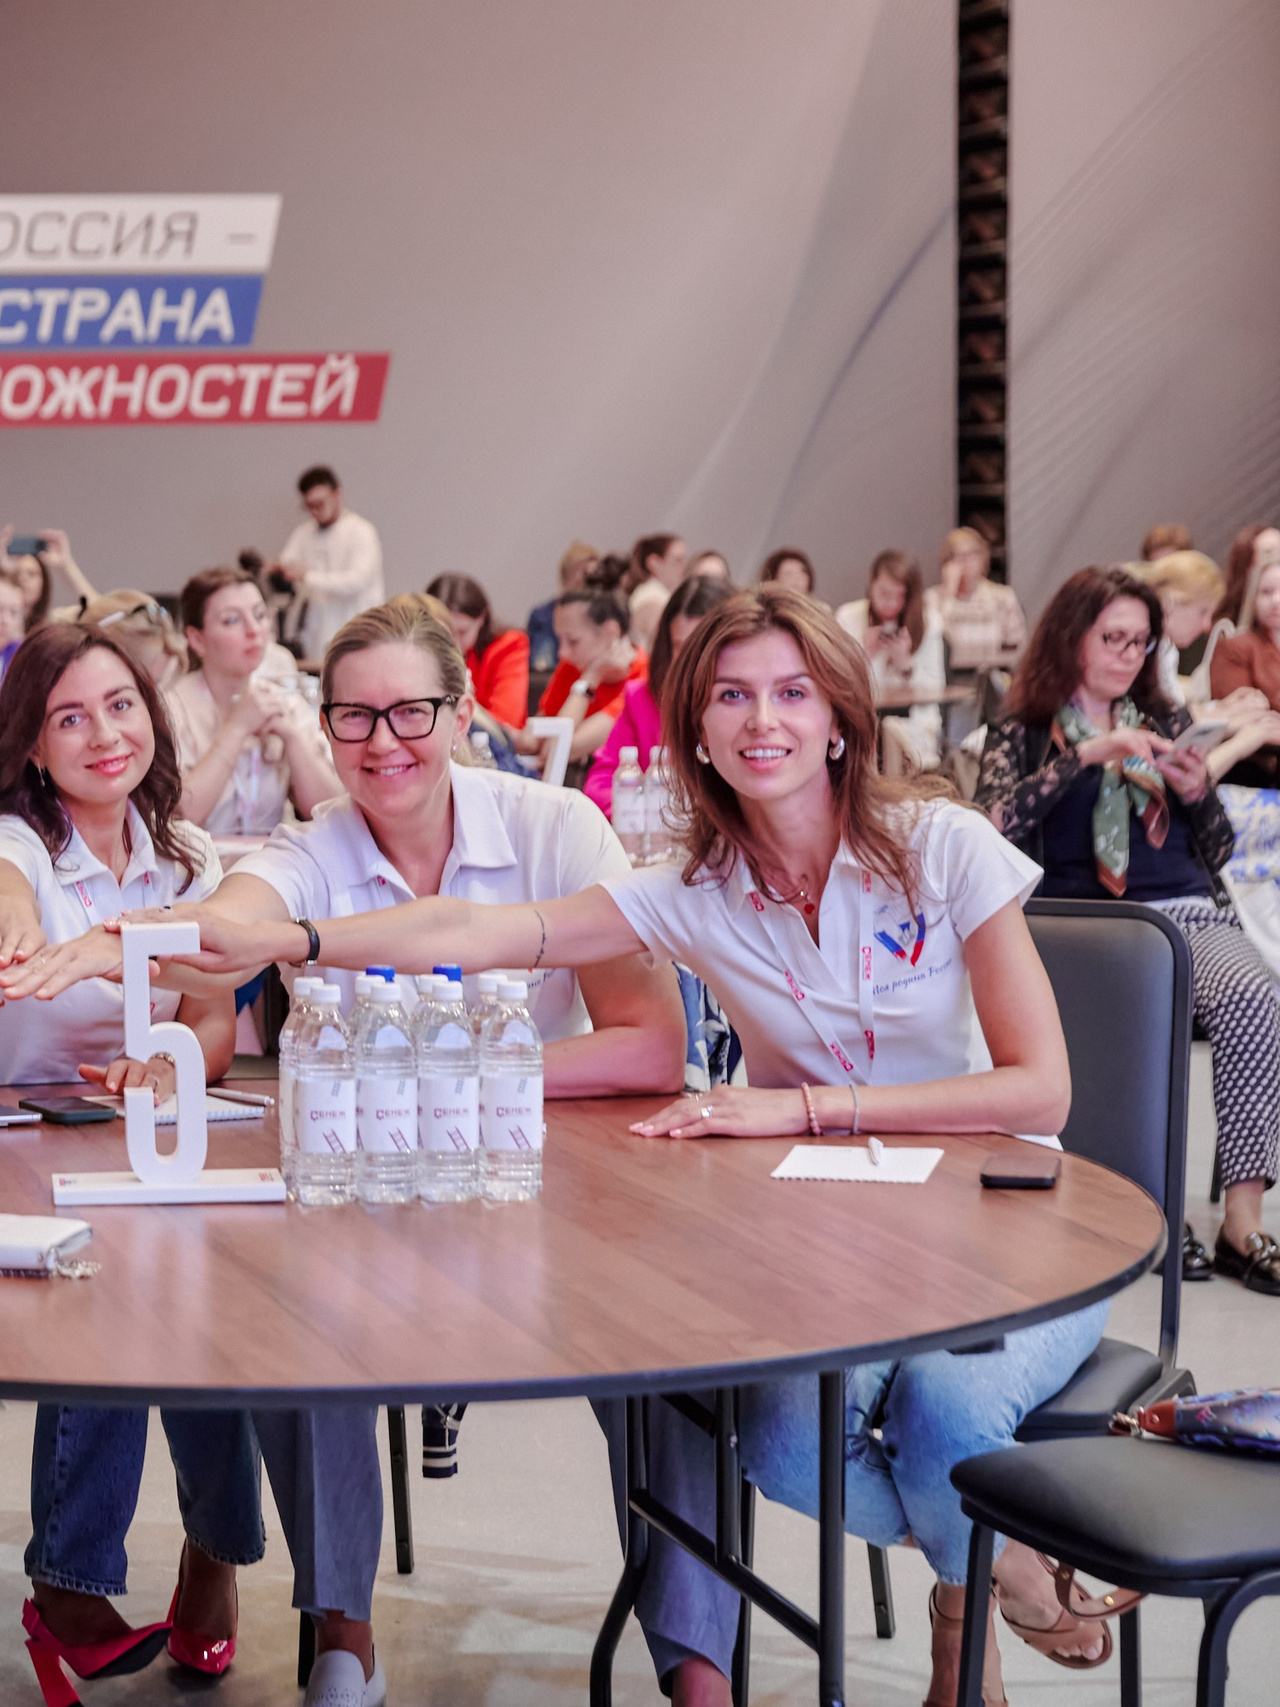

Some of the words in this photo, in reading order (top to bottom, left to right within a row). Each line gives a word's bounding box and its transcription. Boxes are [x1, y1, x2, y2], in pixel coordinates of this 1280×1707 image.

[121, 921, 207, 1186] 5
[310, 1109, 346, 1121] СЕНЕЖ
[375, 1109, 410, 1120] СЕНЕЖ
[433, 1107, 469, 1120] СЕНЕЖ
[495, 1106, 532, 1118] СЕНЕЖ
